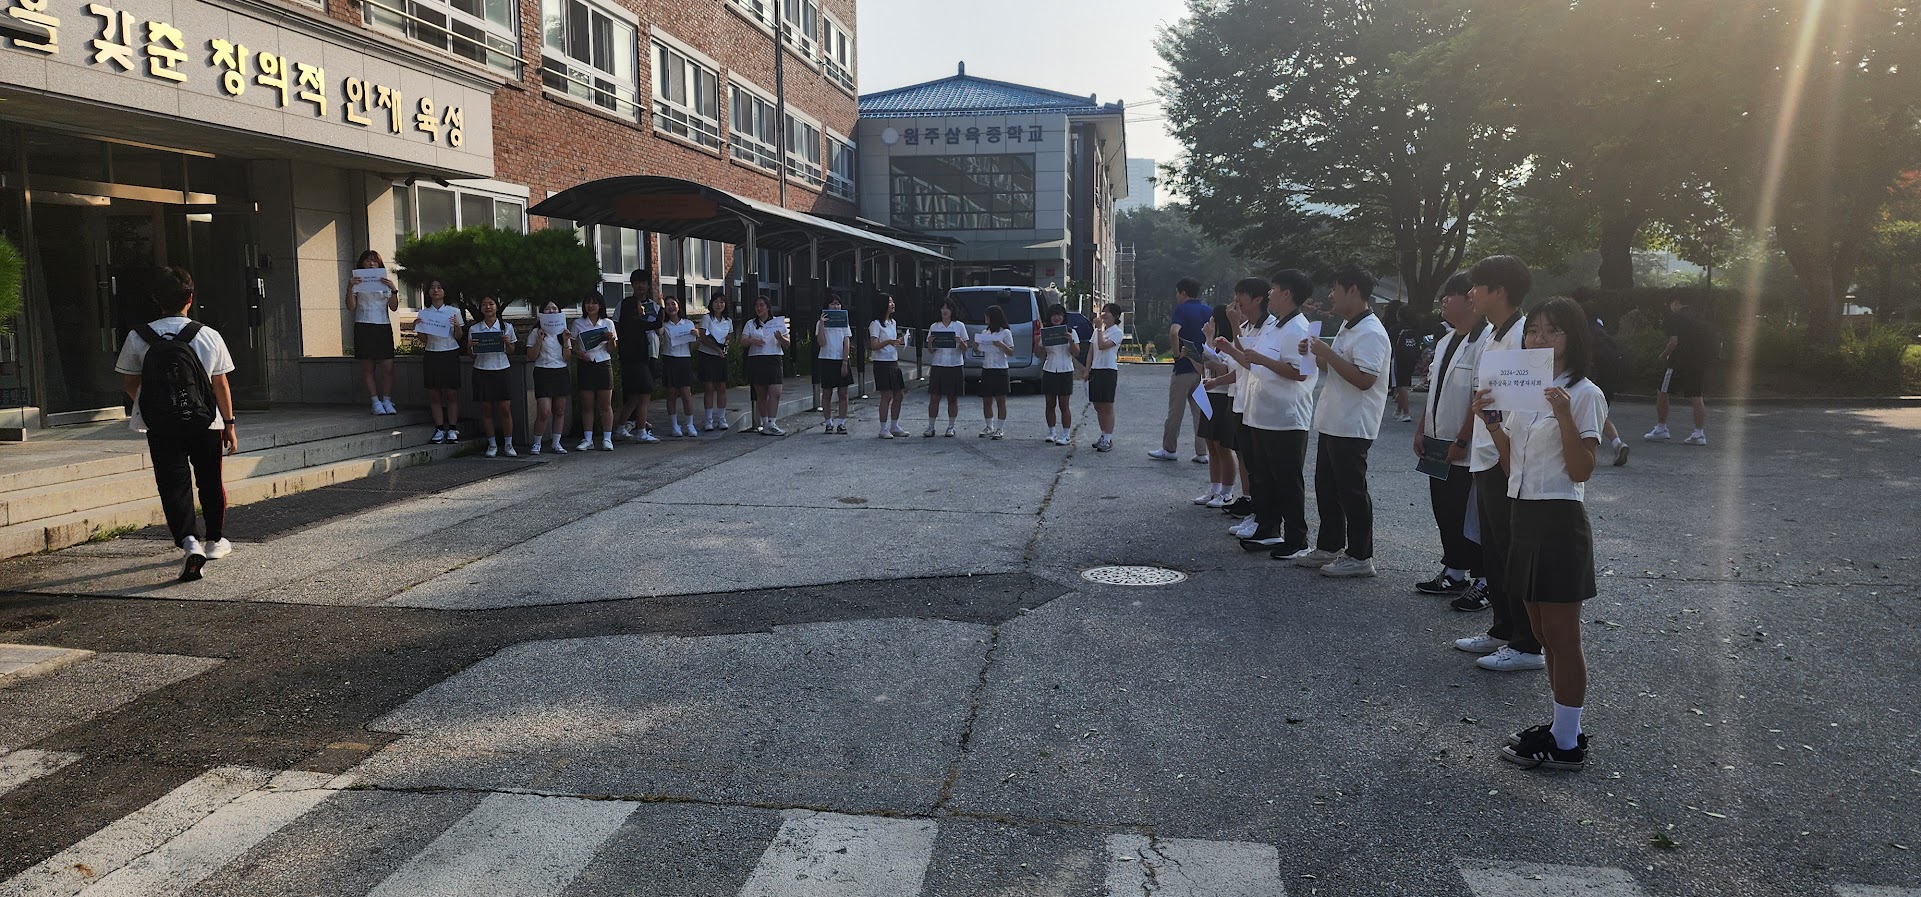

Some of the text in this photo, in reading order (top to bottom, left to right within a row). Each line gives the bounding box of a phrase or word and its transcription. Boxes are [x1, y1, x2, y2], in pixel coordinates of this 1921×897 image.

[89, 3, 188, 82] 갖춘
[212, 38, 327, 117] 창의적
[346, 77, 402, 134] 인재
[416, 97, 464, 147] 육성
[904, 125, 1043, 145] 원주삼육중학교
